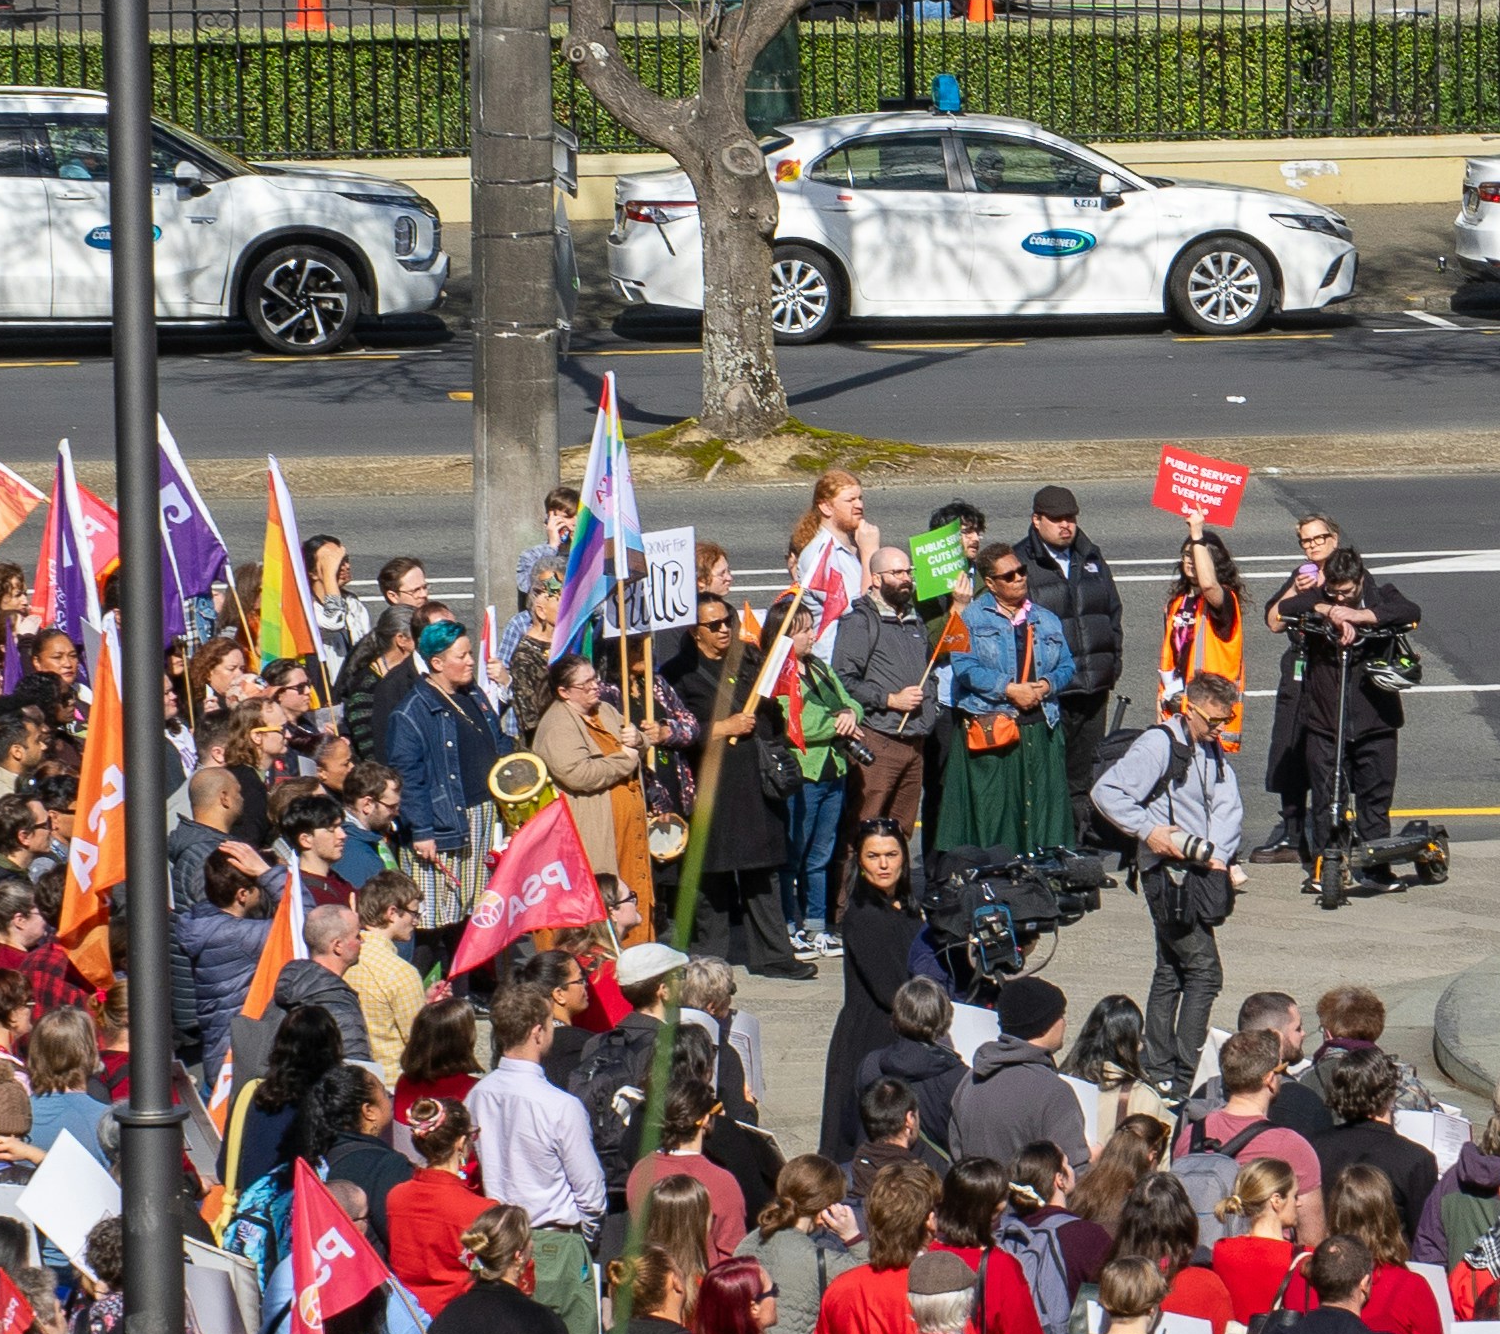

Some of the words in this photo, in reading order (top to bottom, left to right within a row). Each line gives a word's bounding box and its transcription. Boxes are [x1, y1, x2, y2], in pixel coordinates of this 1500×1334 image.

[1029, 235, 1078, 249] COMBINED
[1163, 456, 1198, 477] PUBLIC
[1199, 466, 1242, 487] SERVICE
[1172, 472, 1199, 491] CUTS
[1200, 478, 1228, 497] HURT
[1171, 483, 1223, 508] EVERYONE
[915, 540, 946, 556] PUBLIC
[927, 551, 949, 565] CUTS
